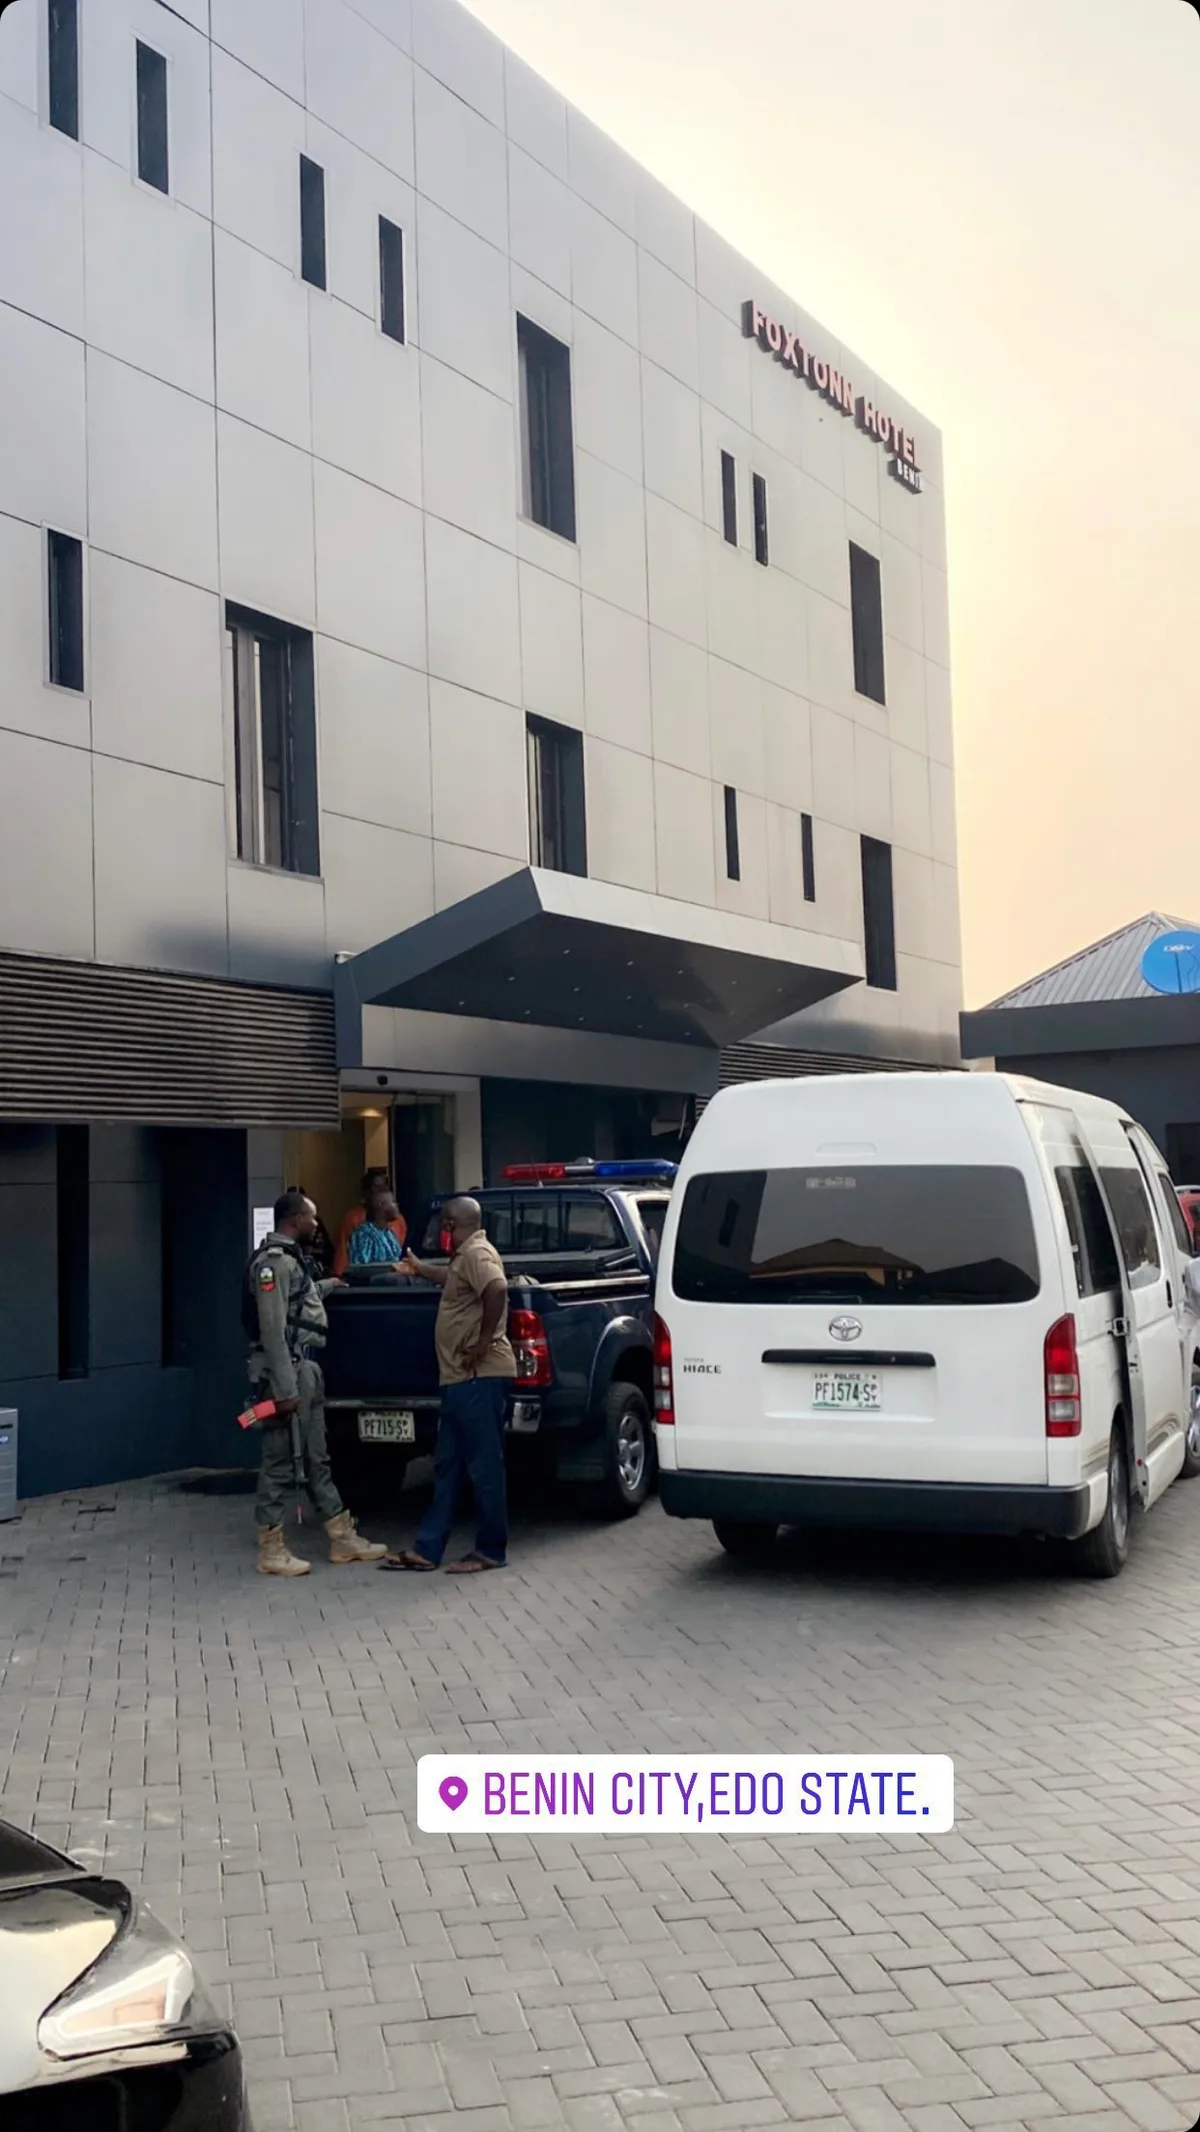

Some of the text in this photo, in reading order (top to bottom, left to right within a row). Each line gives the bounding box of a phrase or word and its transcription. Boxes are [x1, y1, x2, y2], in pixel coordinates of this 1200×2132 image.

[747, 300, 921, 471] FOXTONN HOTEL
[683, 1364, 722, 1374] HIACE
